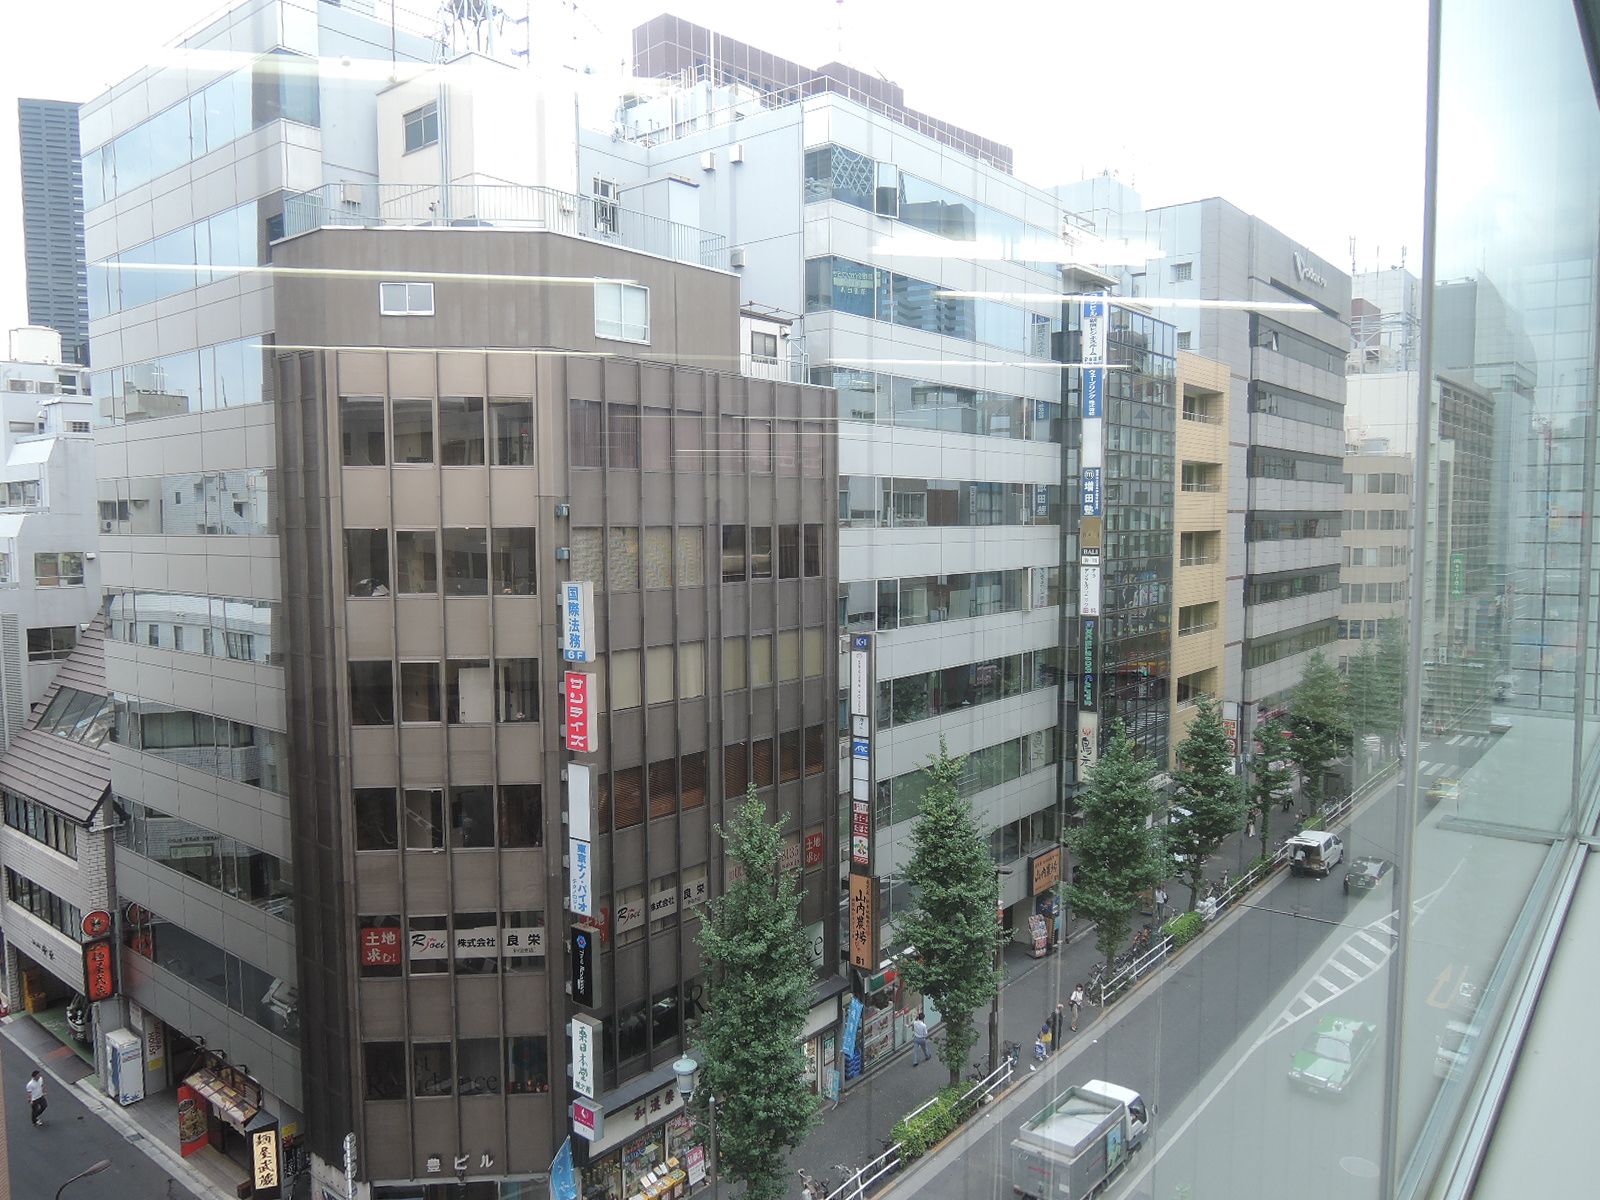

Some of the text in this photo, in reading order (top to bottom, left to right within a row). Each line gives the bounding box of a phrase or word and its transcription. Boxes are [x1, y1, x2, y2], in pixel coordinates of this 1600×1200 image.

[1083, 480, 1094, 516] 増田塾
[567, 586, 581, 649] 国際法務
[569, 678, 585, 748] サンライズ
[650, 896, 675, 911] 株式会社
[854, 888, 867, 945] 山内農場
[365, 932, 396, 946] 土地
[457, 937, 496, 947] 株式会社
[506, 933, 541, 947] 良栄
[855, 956, 865, 966] B1
